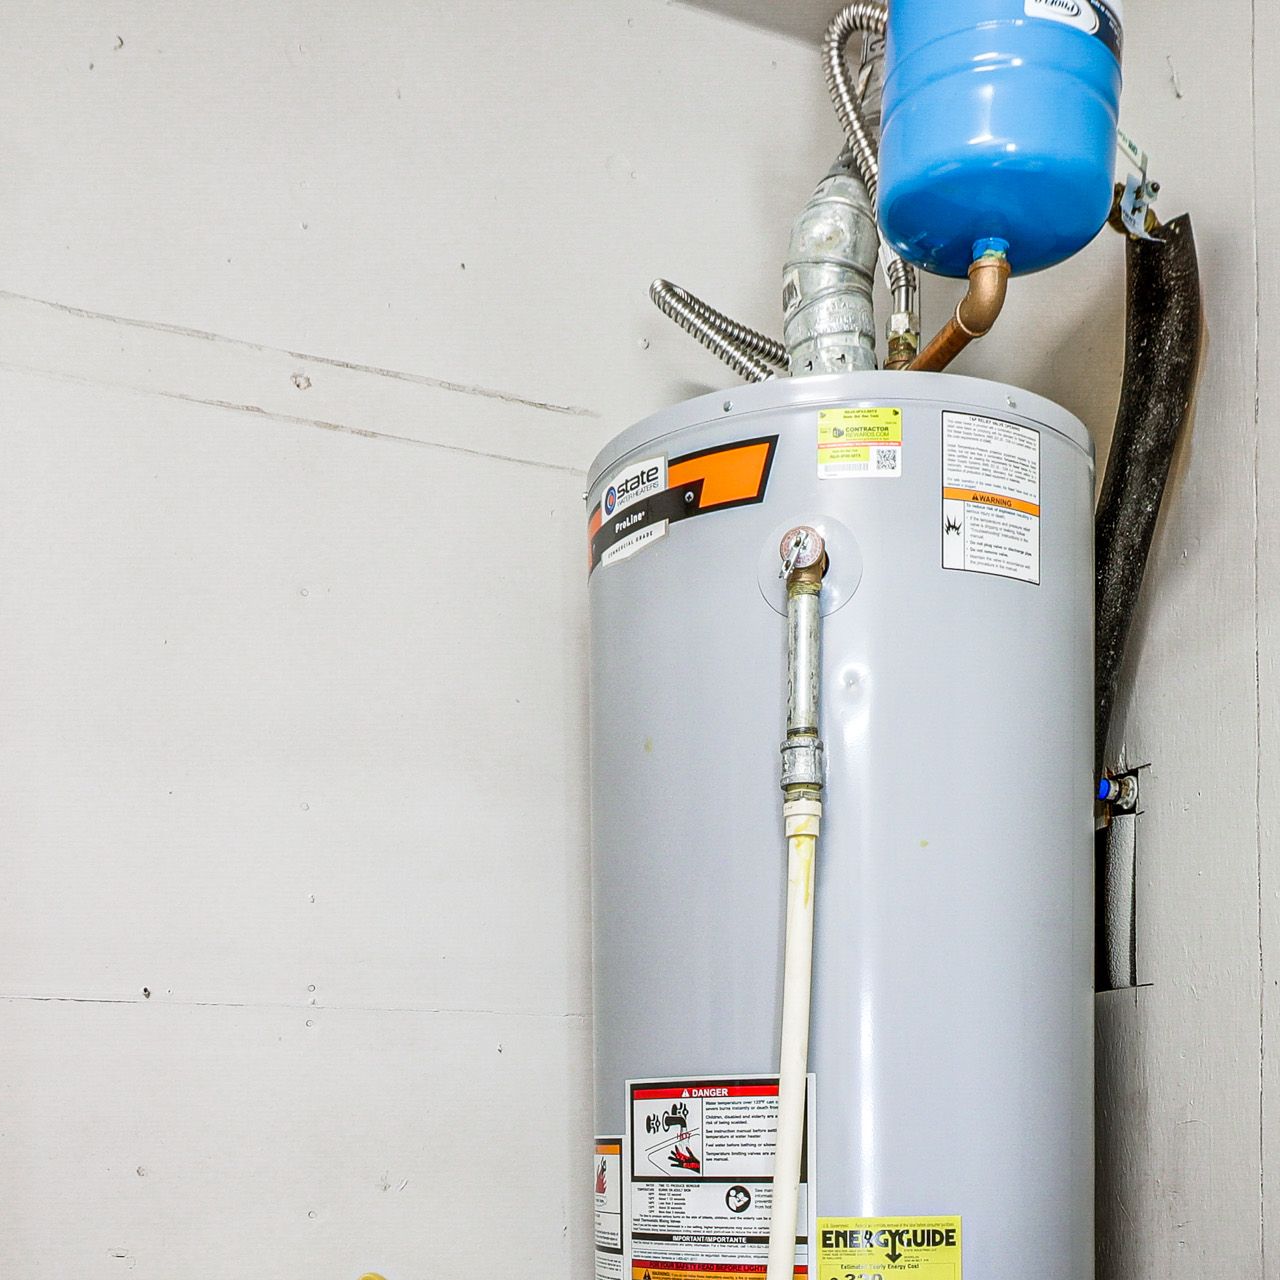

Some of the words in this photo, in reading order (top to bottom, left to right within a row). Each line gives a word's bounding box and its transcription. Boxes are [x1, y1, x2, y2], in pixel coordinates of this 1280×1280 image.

[617, 466, 659, 500] state
[633, 482, 659, 499] HEATERS
[980, 494, 1012, 508] WARNING
[615, 512, 643, 534] ProLine
[608, 539, 634, 559] COMMERCIAL
[635, 530, 654, 543] GRADE
[692, 1088, 729, 1097] DANGER
[672, 1235, 747, 1244] IMPORTANT/IMPORTANTE
[822, 1229, 957, 1248] ENERGYGUIDE
